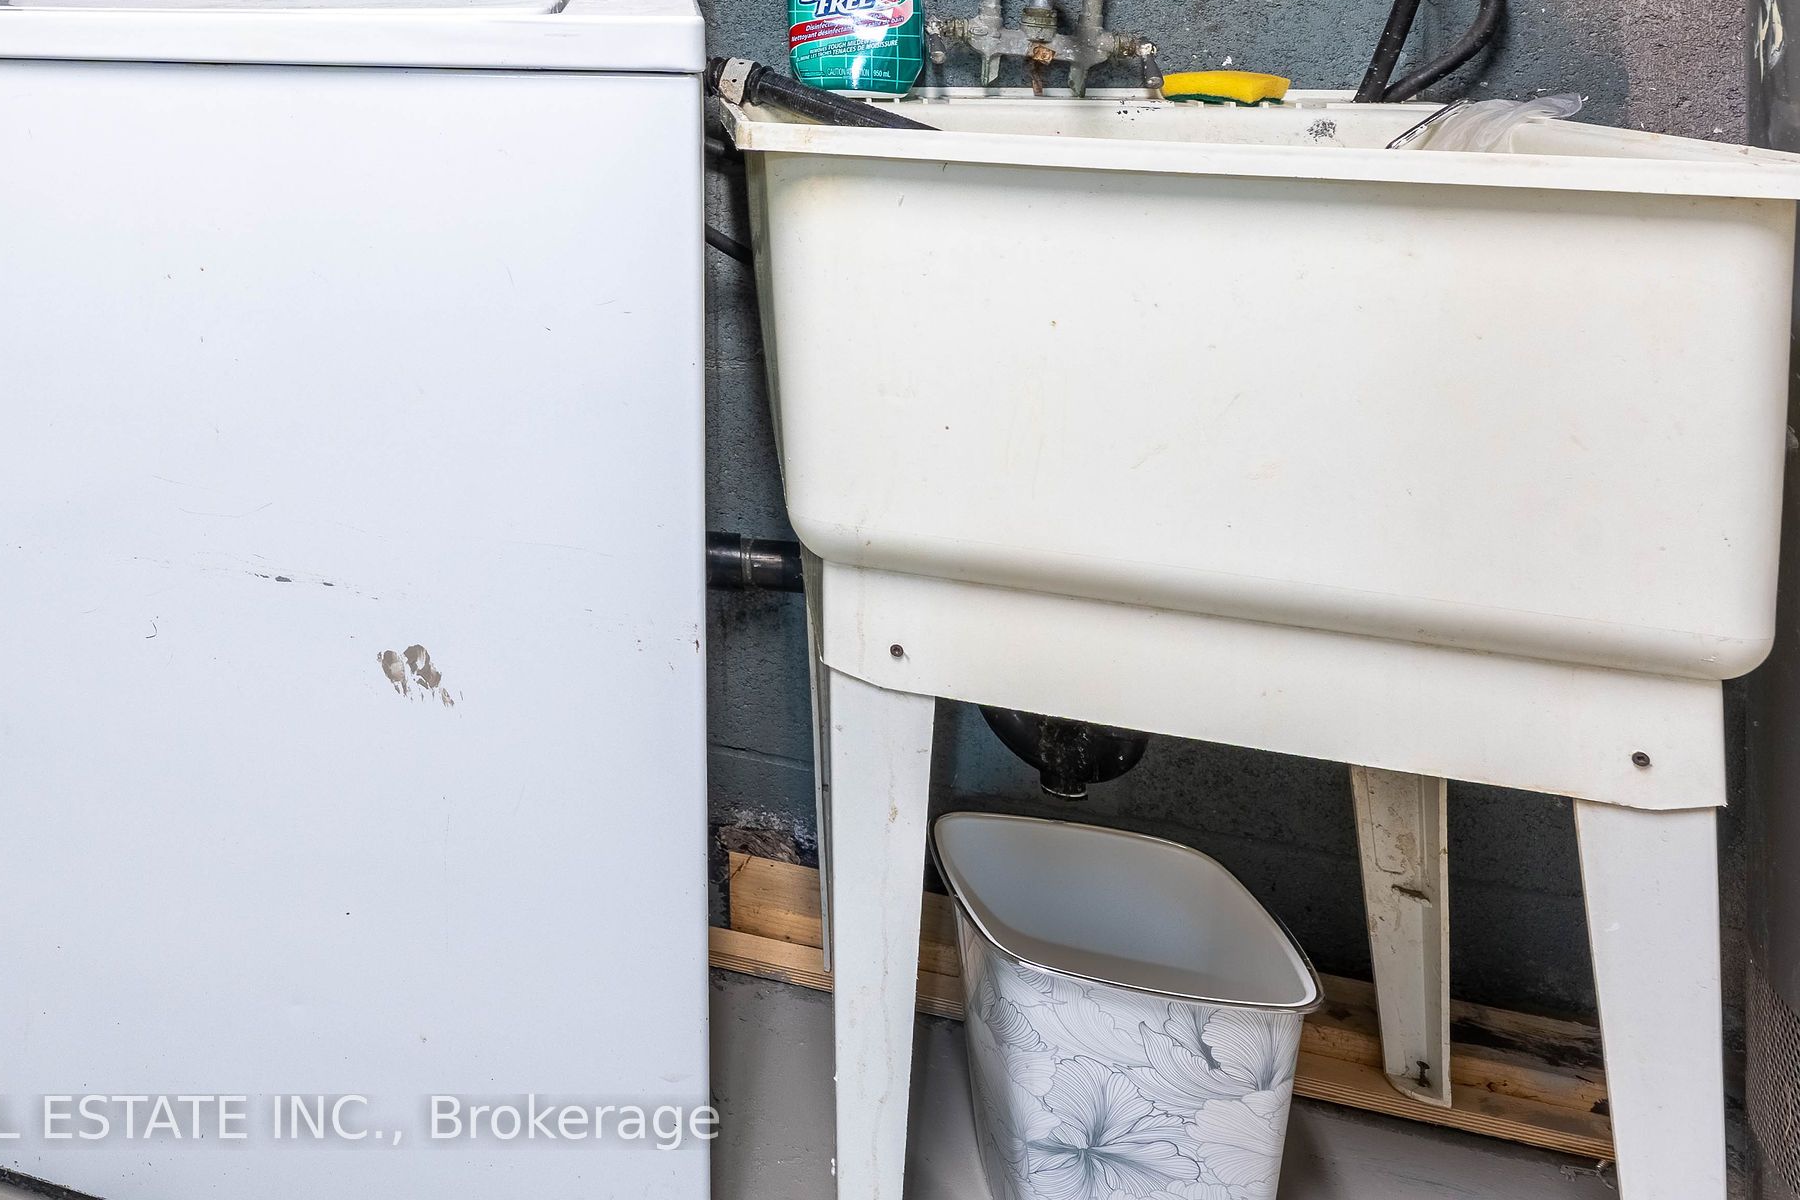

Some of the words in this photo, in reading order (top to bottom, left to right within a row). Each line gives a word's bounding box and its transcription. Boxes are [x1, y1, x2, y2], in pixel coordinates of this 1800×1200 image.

[828, 41, 847, 51] TOUGH
[832, 46, 857, 56] TENACES
[873, 69, 883, 77] 950
